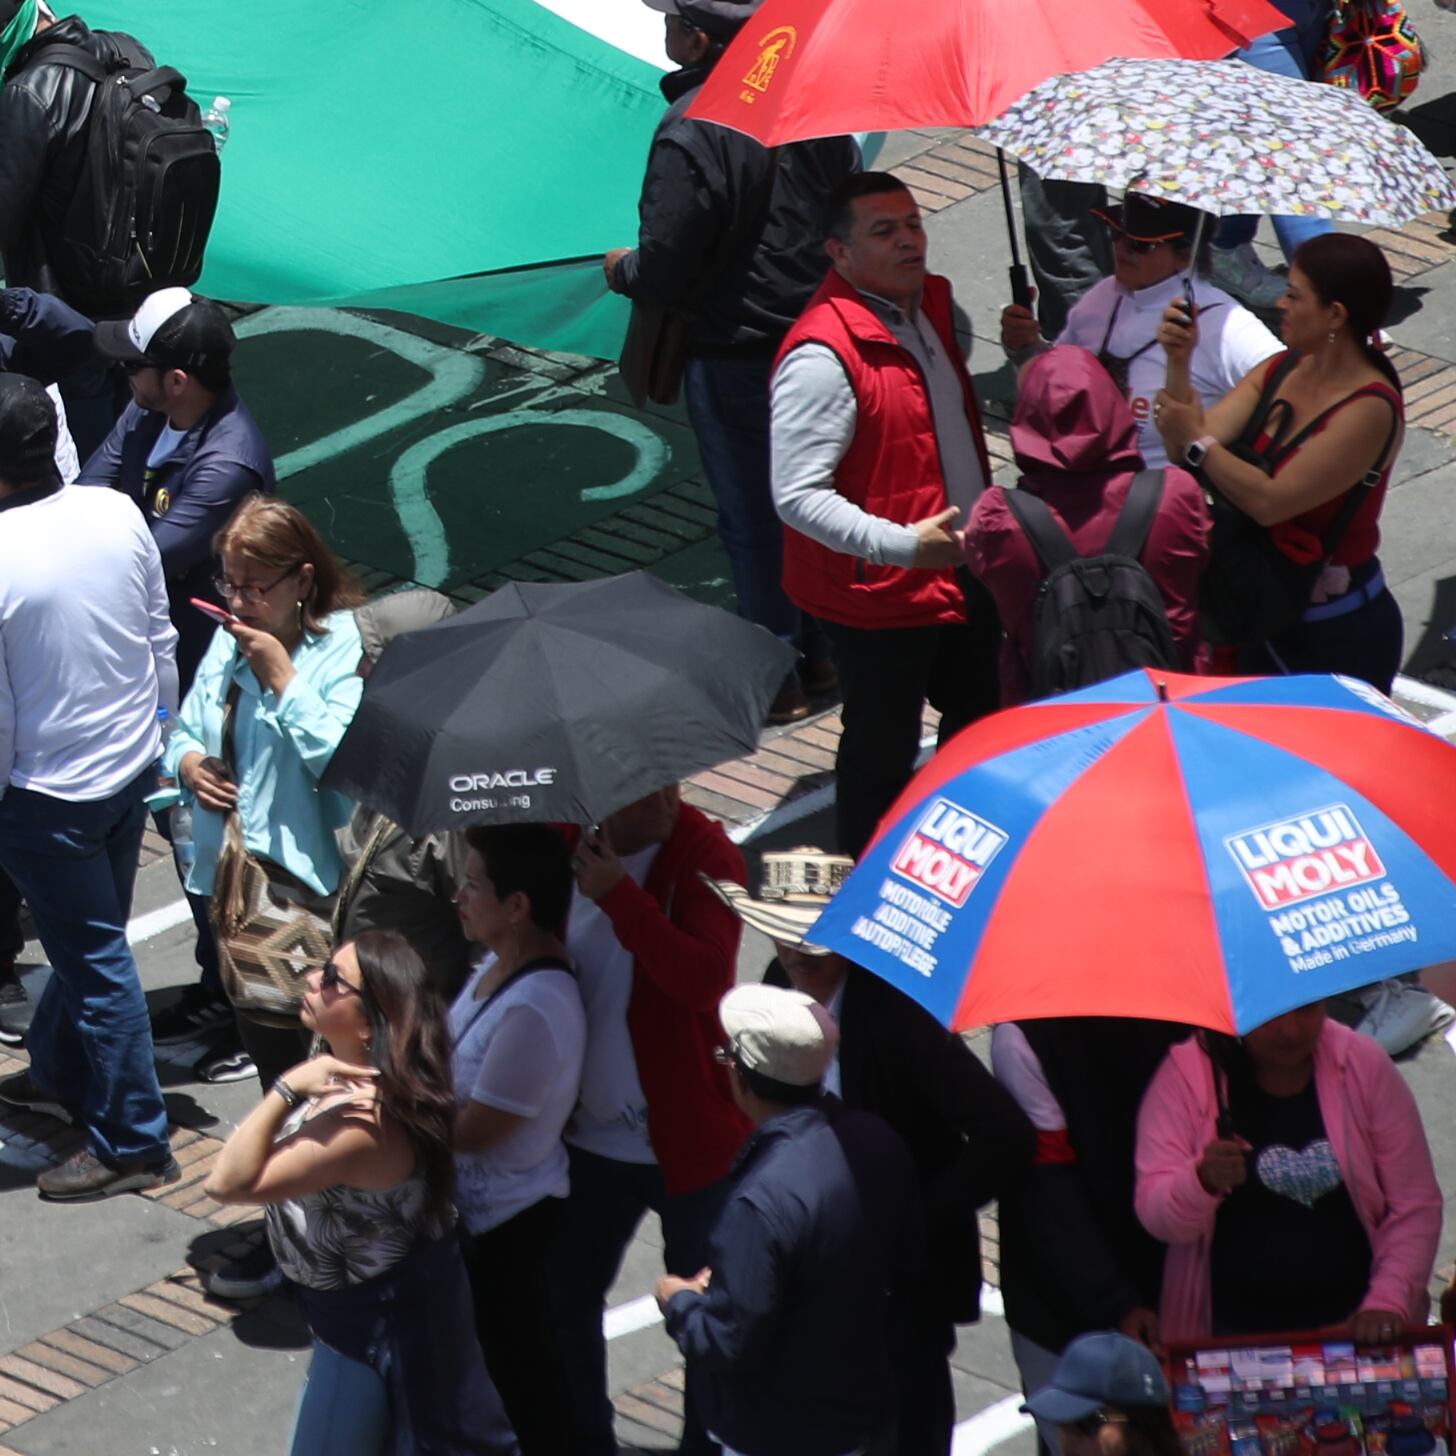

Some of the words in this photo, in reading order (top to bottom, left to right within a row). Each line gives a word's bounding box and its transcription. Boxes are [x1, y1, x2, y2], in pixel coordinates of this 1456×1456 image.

[449, 768, 557, 793] ORACLE
[449, 794, 531, 813] Consung
[918, 802, 1005, 867] LIQUI
[1233, 808, 1357, 870] LIQUI
[897, 833, 980, 900] MOLY
[1252, 841, 1372, 904] MOLY
[873, 901, 939, 951] ADDITIVE
[1269, 896, 1350, 937] MOTOR
[1346, 881, 1401, 914] OILS
[1280, 935, 1304, 957] &
[1300, 903, 1411, 952] ADDITIVES
[1288, 948, 1334, 974] Made
[1334, 946, 1350, 961] in
[1349, 924, 1418, 955] Germany
